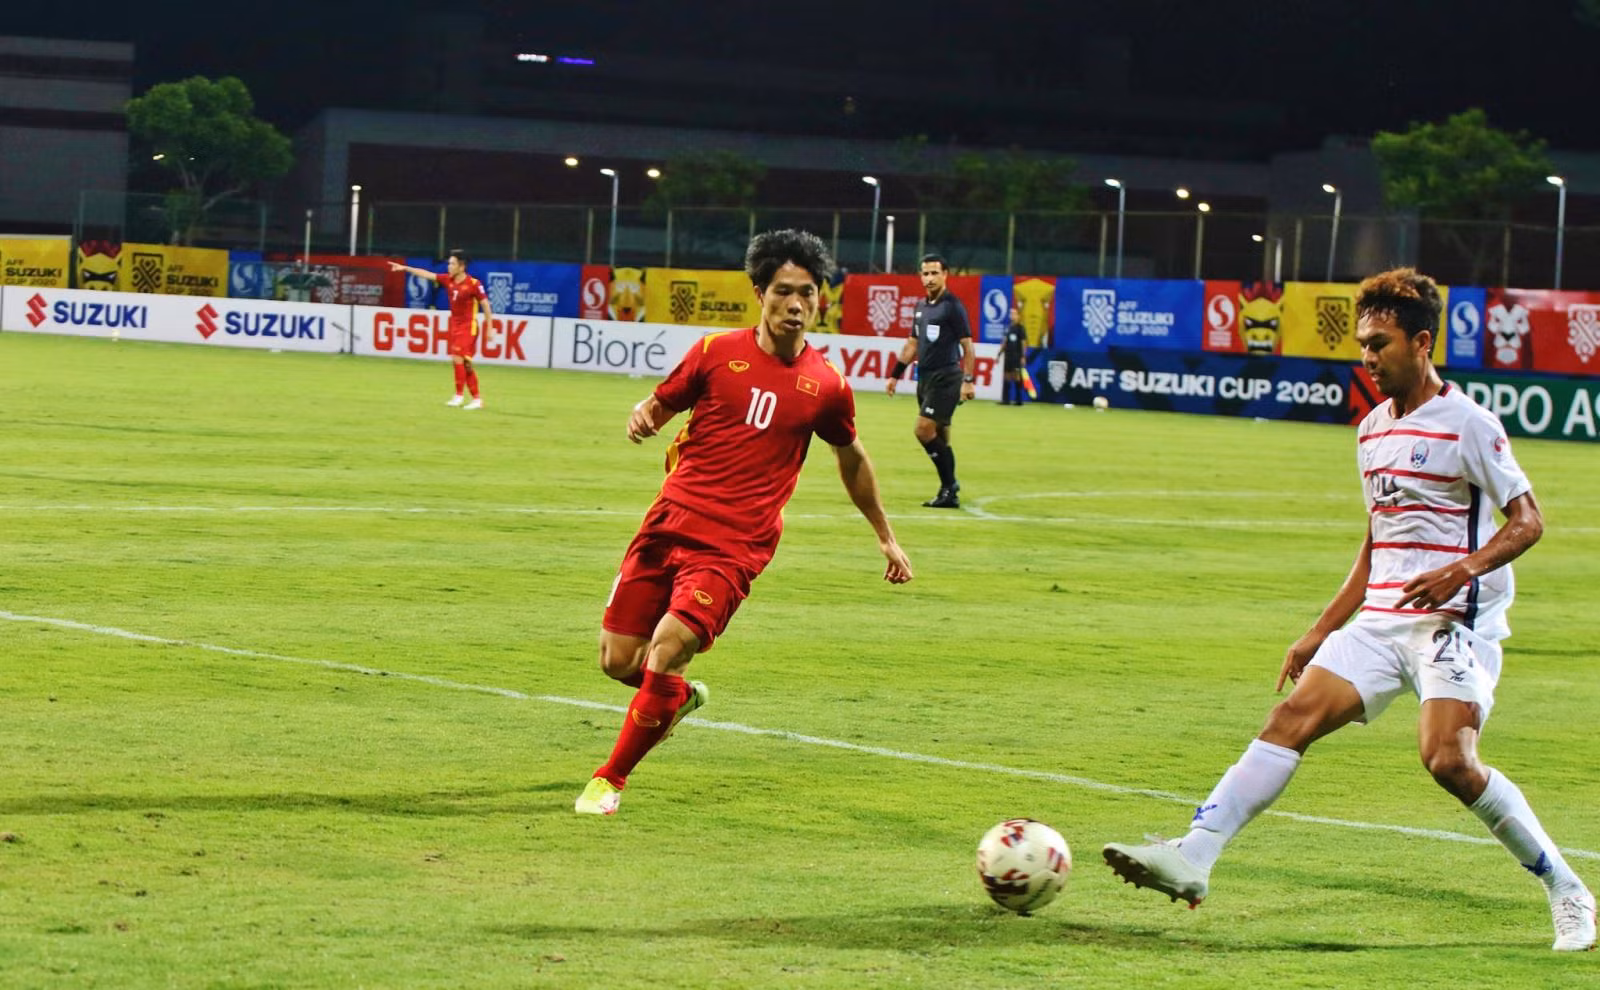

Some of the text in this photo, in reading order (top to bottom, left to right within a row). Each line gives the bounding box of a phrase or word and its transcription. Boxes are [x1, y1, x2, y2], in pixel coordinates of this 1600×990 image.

[6, 267, 62, 278] SUZUKI
[166, 274, 219, 288] SUZUKI
[514, 292, 558, 304] SUZUKI
[700, 300, 747, 312] SUZUKI
[1118, 301, 1137, 310] AFF
[53, 300, 147, 329] SUZUKI
[225, 311, 325, 340] SUZUKI
[1117, 311, 1175, 326] SUZUKI
[373, 312, 528, 361] G-SHCK
[1116, 325, 1139, 336] CUP
[572, 323, 667, 370] Bioré
[1070, 367, 1343, 406] AFF SUZUKI CUP 2020
[745, 387, 777, 430] 10
[1444, 379, 1600, 438] PPO A
